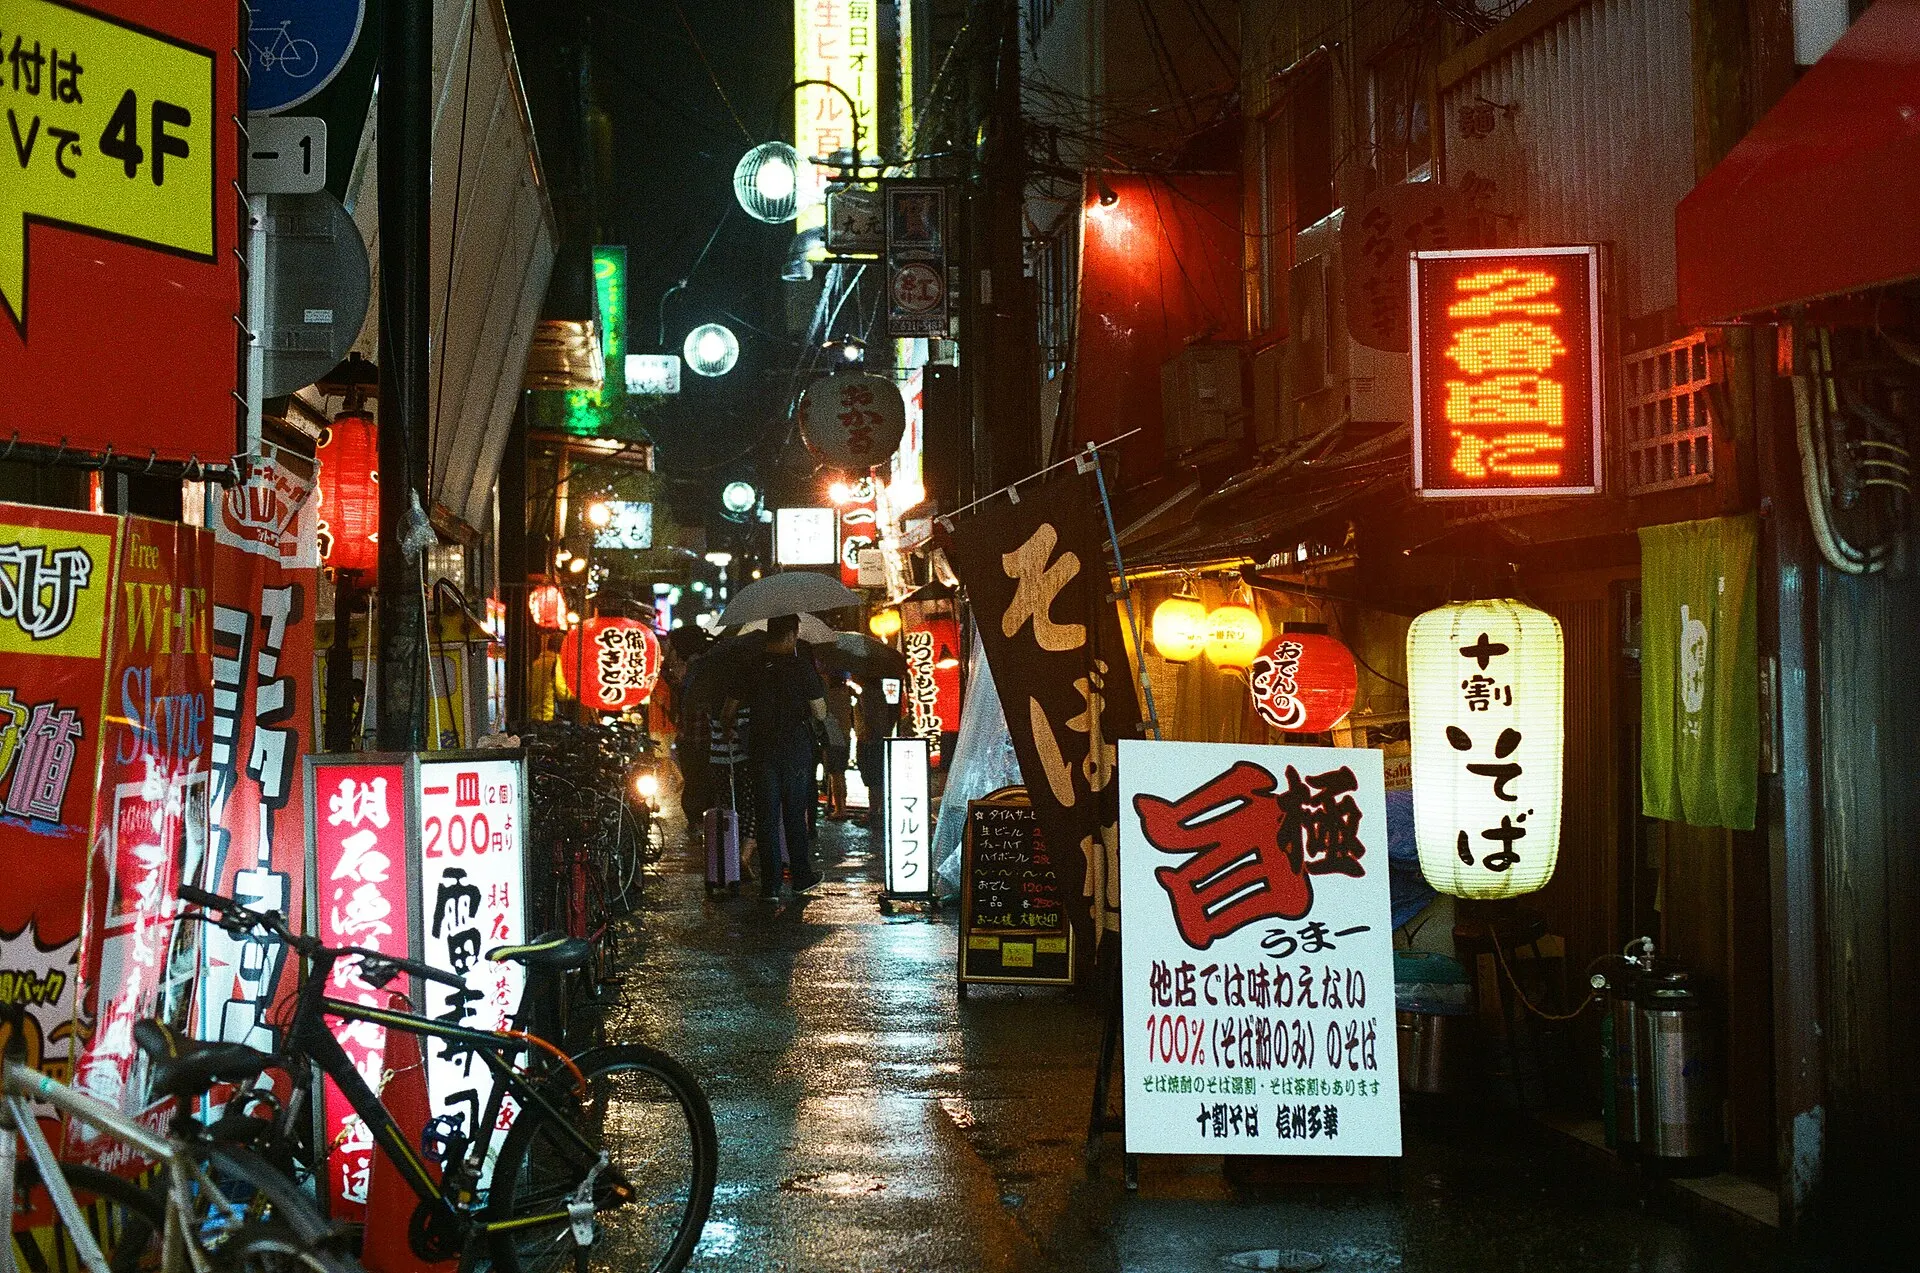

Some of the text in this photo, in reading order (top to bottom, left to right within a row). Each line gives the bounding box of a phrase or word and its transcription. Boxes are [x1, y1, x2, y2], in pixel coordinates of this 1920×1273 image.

[0, 34, 84, 104] 付は
[99, 88, 192, 187] 4F
[129, 533, 160, 569] Free
[125, 582, 208, 654] Wi-Fi
[596, 626, 625, 705] やきとり
[116, 666, 205, 766] Skype
[1446, 631, 1534, 872] 十割そば
[899, 796, 920, 880] マルフク
[978, 880, 1011, 891] おでん
[1149, 959, 1367, 1010] 他店では味わえない
[1196, 1102, 1339, 1139] 十割そば 信州多華
